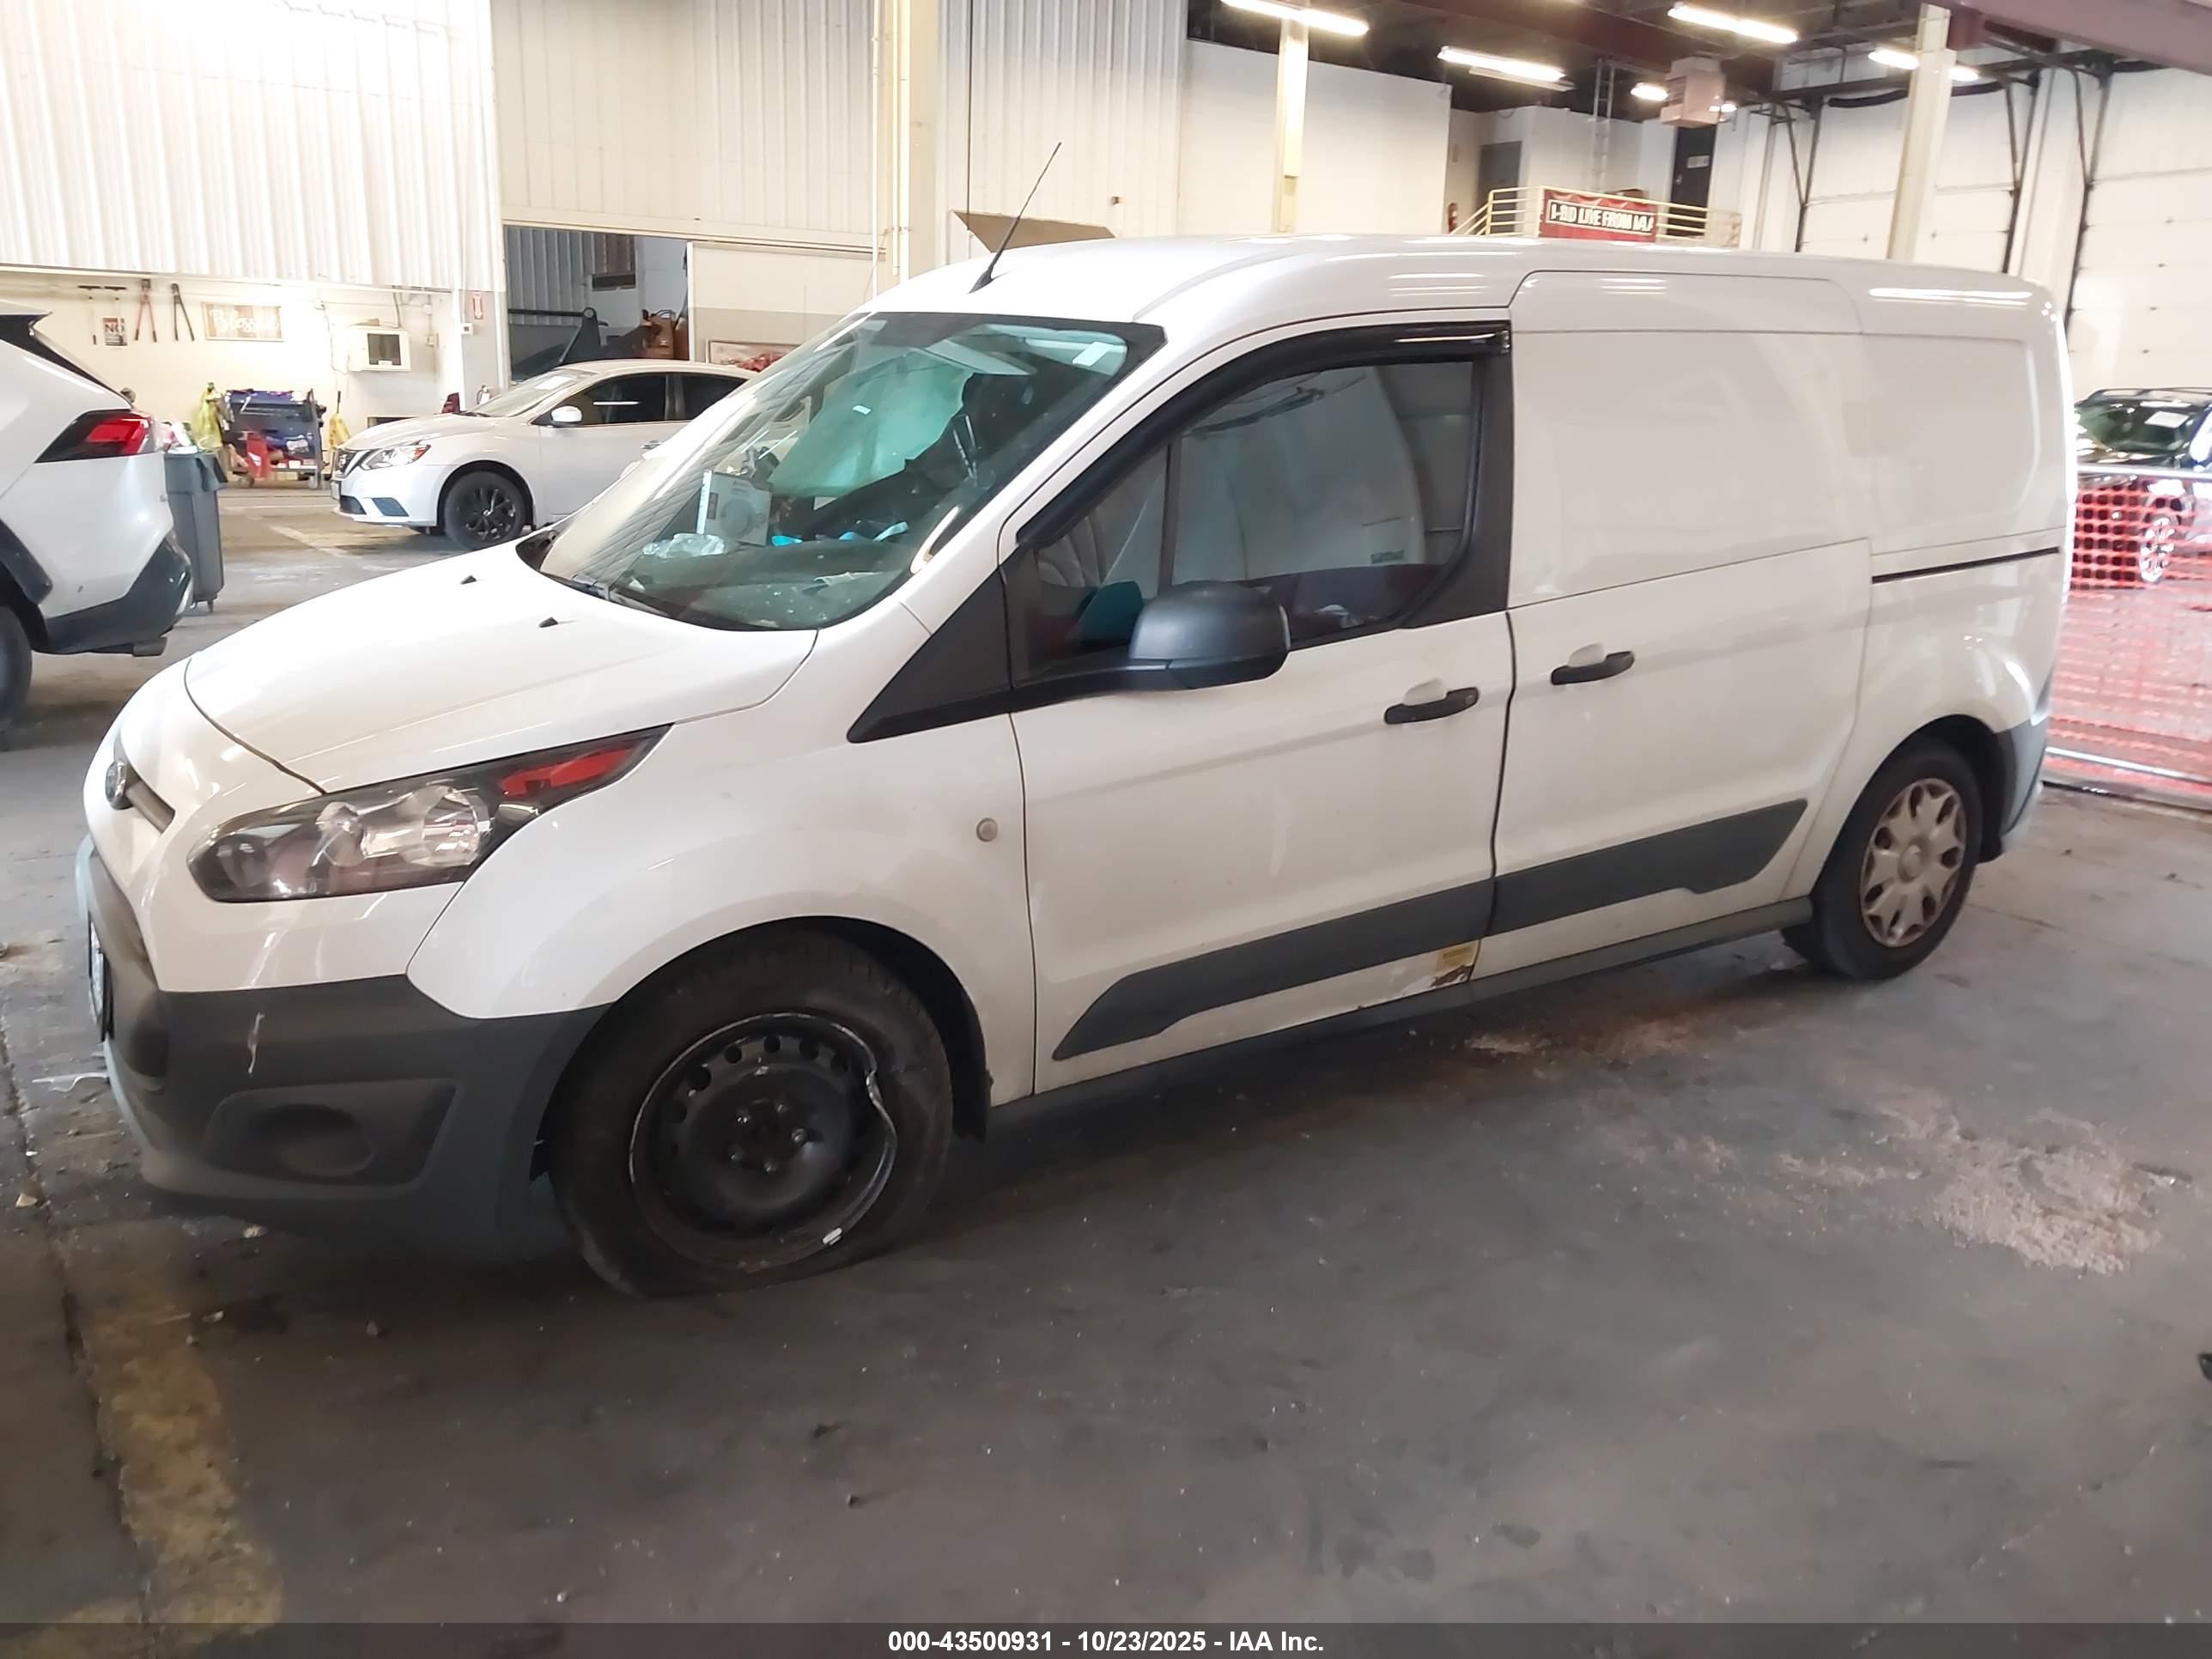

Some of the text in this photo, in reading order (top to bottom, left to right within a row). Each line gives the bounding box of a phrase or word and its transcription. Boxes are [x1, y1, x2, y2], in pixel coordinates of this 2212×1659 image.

[1577, 208, 1602, 226] LIVE
[1601, 210, 1632, 229] FROM
[104, 324, 125, 334] NO
